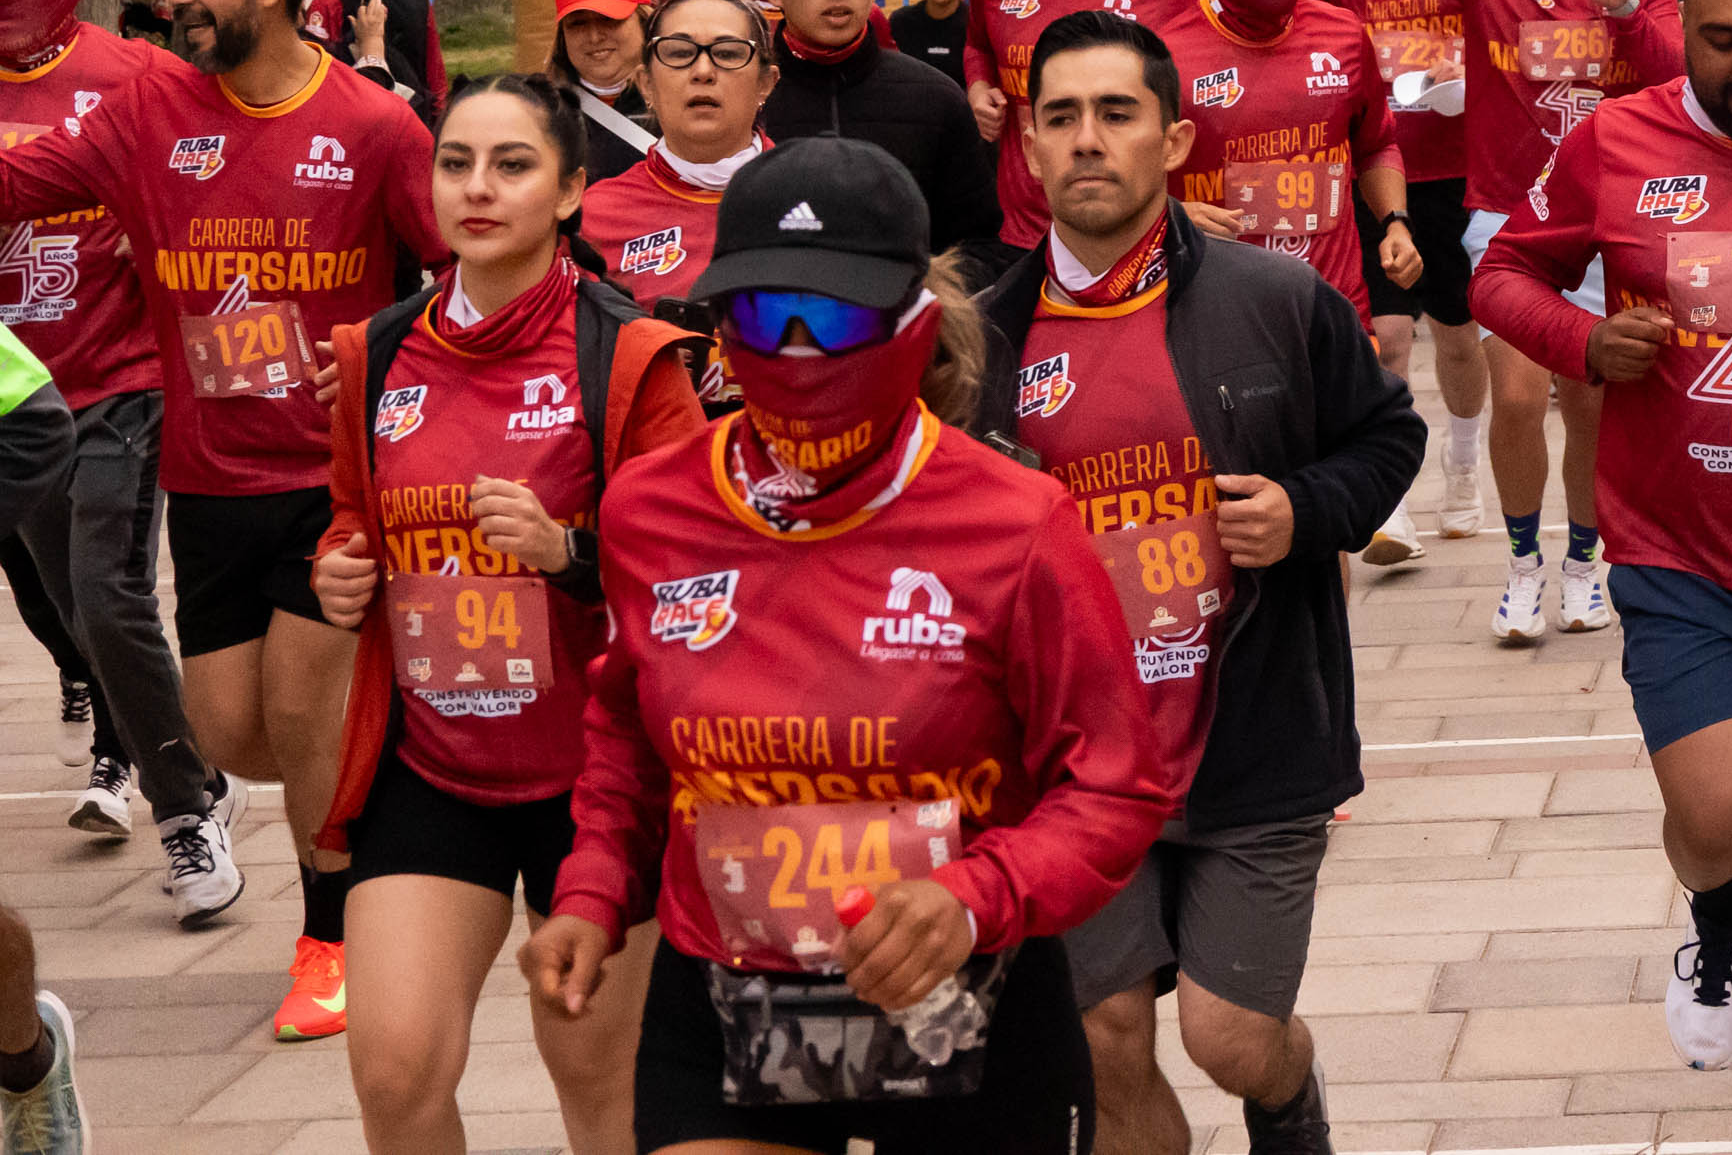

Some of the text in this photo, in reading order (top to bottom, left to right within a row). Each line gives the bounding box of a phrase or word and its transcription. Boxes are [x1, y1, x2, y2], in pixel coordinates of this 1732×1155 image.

[1553, 27, 1604, 60] 266
[1196, 70, 1236, 91] RUBA
[1306, 72, 1349, 89] ruba
[176, 137, 221, 153] RUBA
[1225, 122, 1328, 161] CARRERA DE
[171, 151, 218, 167] RACE
[294, 162, 355, 182] ruba
[1276, 171, 1315, 210] 99
[1646, 176, 1701, 196] RUBA
[1639, 190, 1702, 213] RACE
[189, 218, 313, 247] CARRERA DE
[627, 229, 677, 256] RUBA
[46, 250, 76, 260] AÑOS
[623, 242, 677, 270] RACE
[212, 313, 287, 367] 120
[1021, 374, 1063, 405] ACE
[507, 405, 575, 430] ruba
[1137, 530, 1207, 595] 88
[656, 574, 729, 605] RUBA
[455, 589, 522, 650] 94
[654, 598, 726, 626] RACE
[862, 613, 967, 646] ruba
[1144, 663, 1190, 679] VALOR
[437, 702, 467, 713] CON
[849, 716, 898, 768] DE
[762, 819, 901, 909] 244
